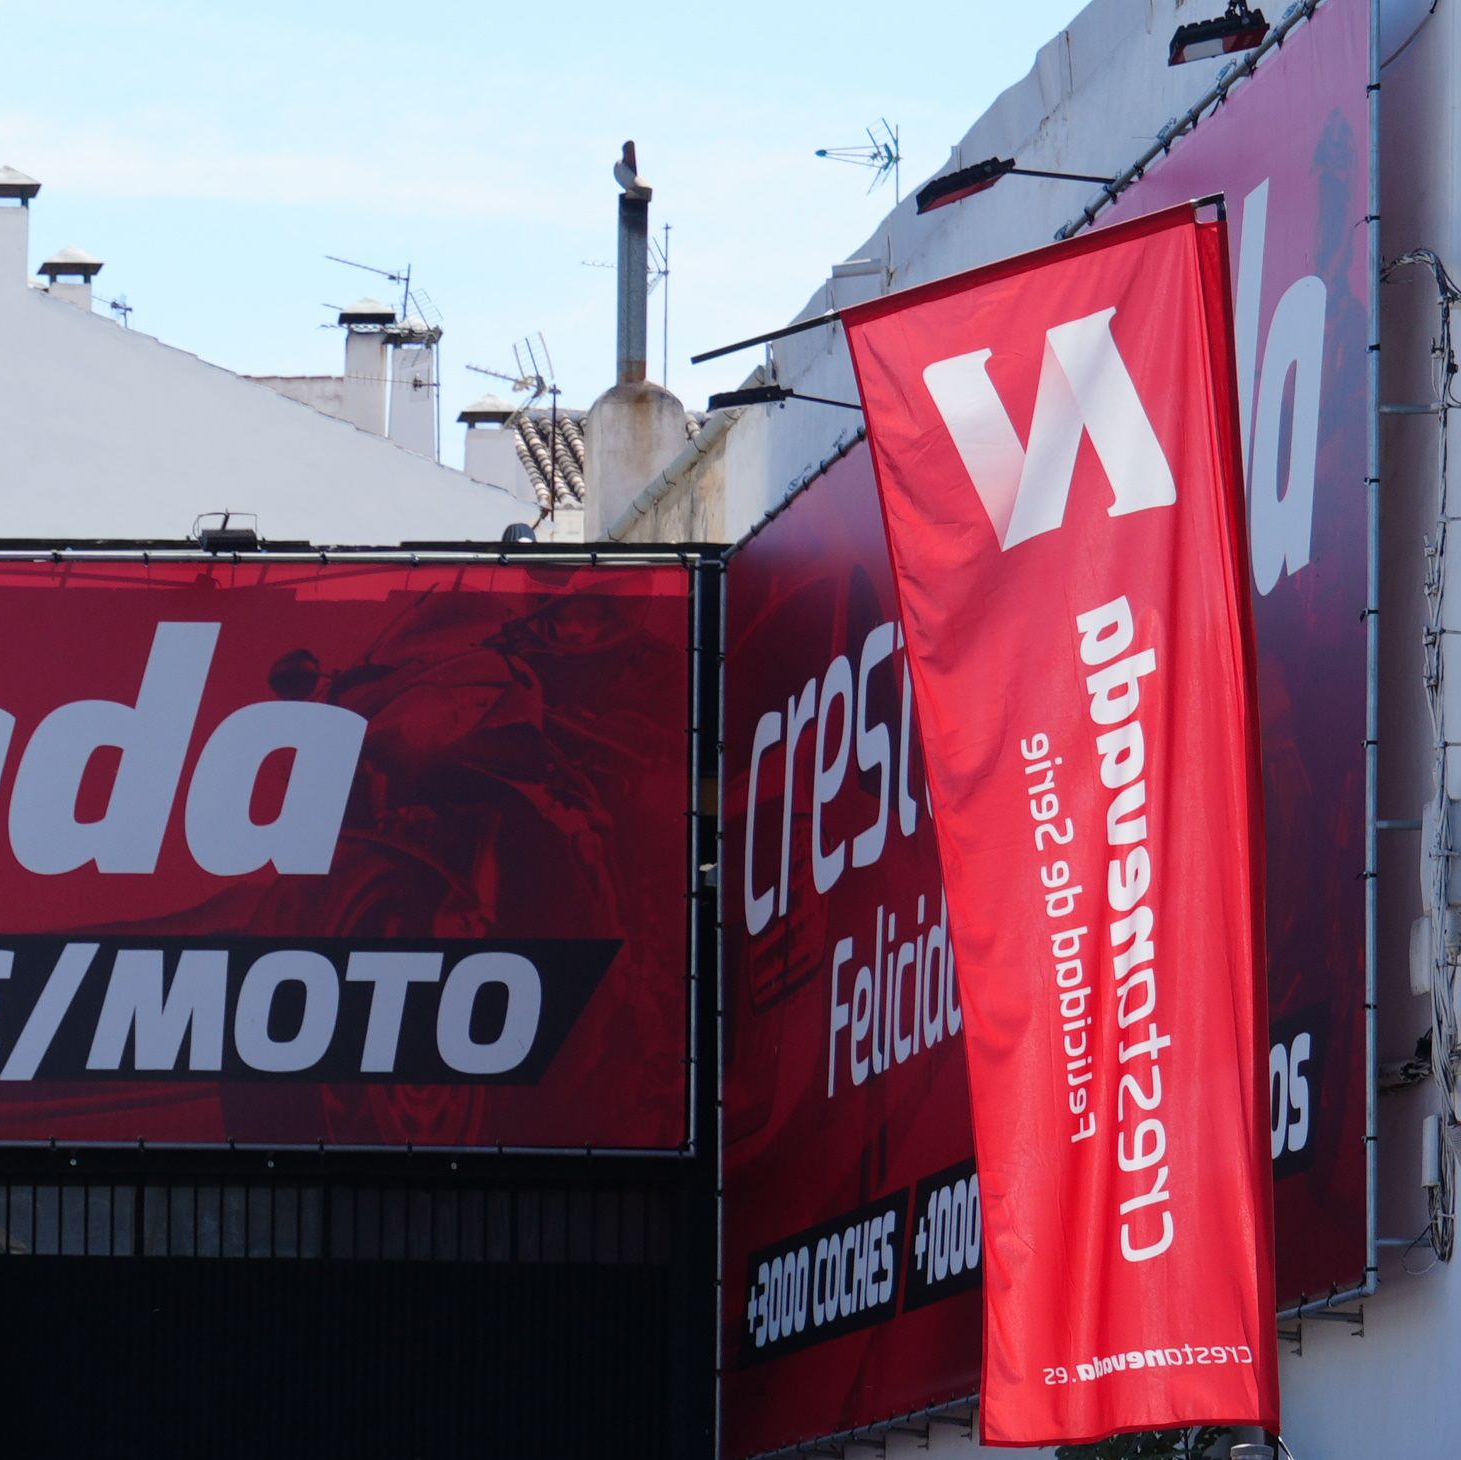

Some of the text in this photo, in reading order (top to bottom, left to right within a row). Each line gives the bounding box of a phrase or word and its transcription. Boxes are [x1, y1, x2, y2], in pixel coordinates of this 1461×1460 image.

[744, 620, 933, 936] crest
[747, 1209, 896, 1348] +3000 COCHES
[914, 1172, 982, 1285] +1000
